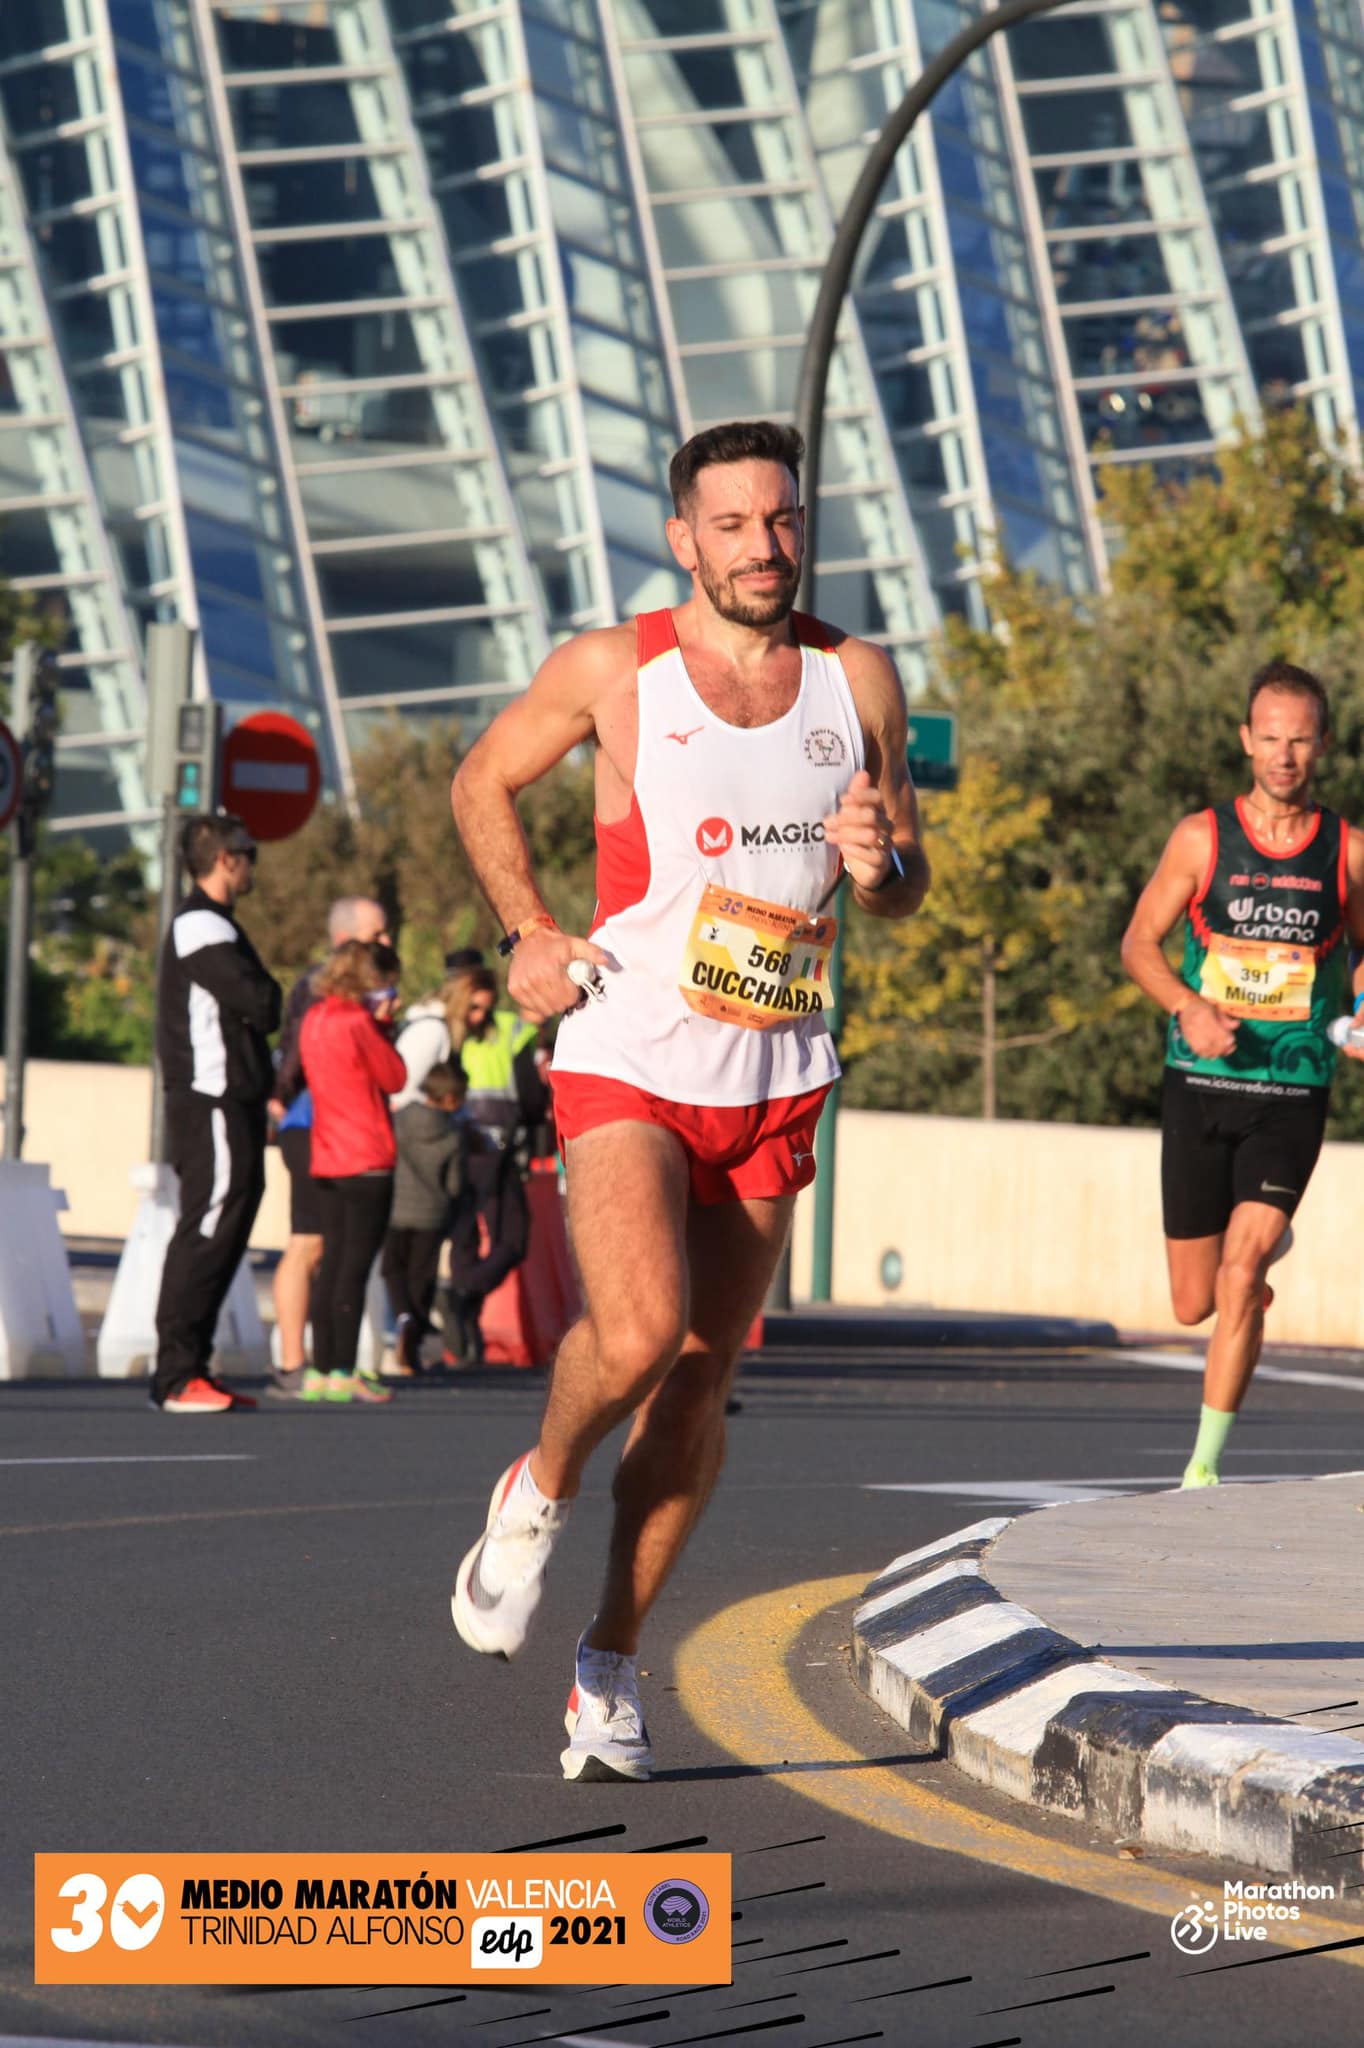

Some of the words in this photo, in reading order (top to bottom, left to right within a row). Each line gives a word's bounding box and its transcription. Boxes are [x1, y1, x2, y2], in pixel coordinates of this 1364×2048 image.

[1227, 896, 1320, 926] Urban
[747, 944, 792, 977] 568
[691, 960, 824, 1014] CUCCHIARA
[1240, 967, 1270, 985] 391
[1225, 985, 1284, 1006] Miguel
